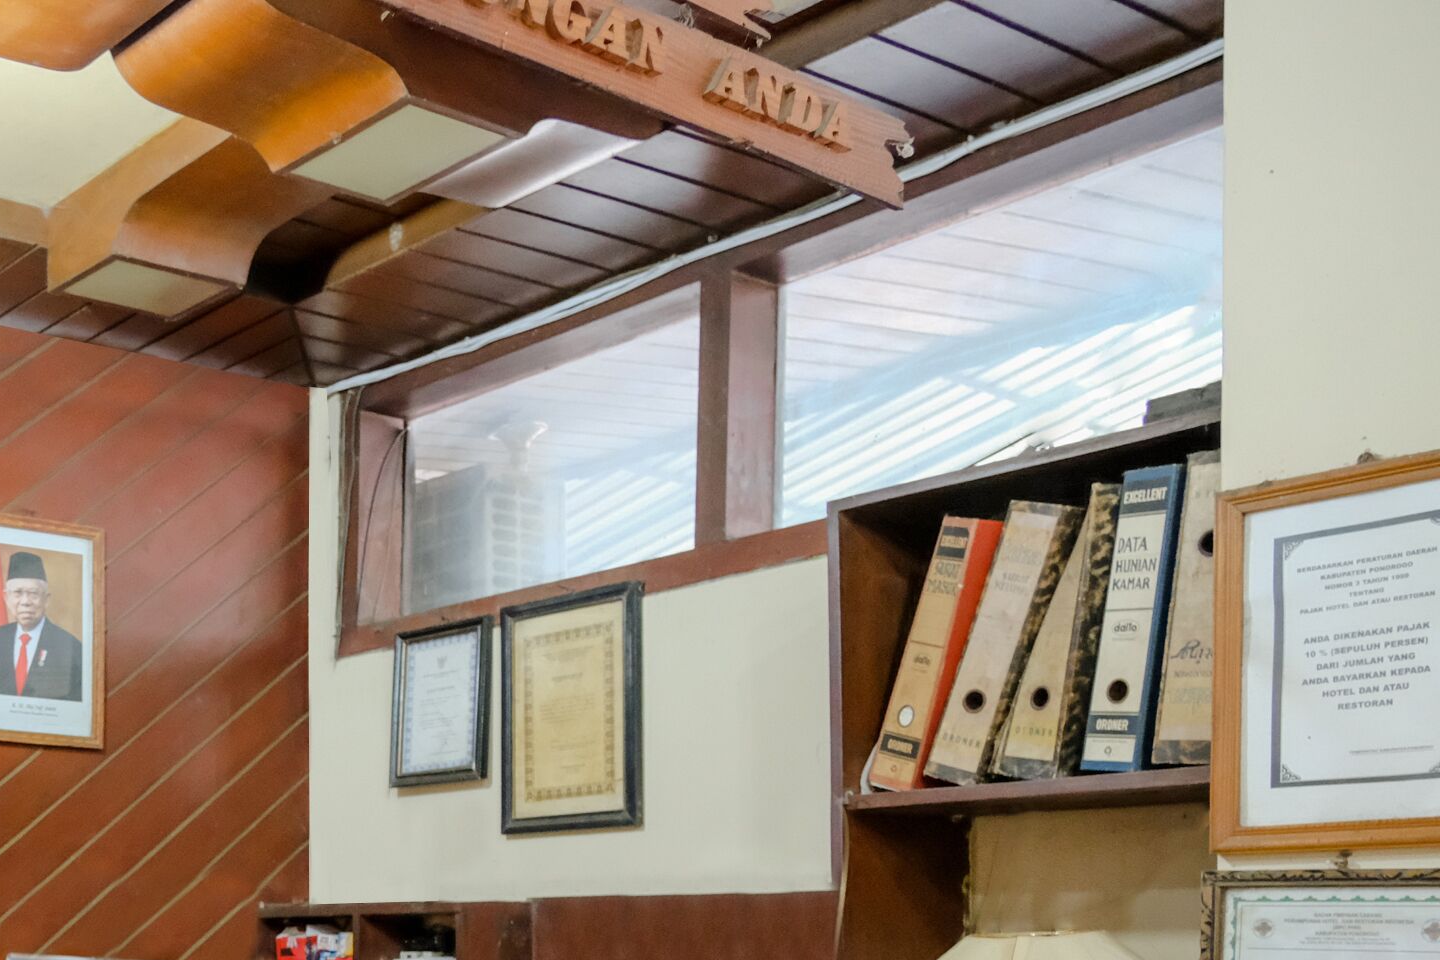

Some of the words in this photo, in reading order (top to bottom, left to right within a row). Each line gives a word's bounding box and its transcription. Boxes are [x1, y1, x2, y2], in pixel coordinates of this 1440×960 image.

[704, 56, 852, 153] ANDA
[1123, 486, 1168, 504] EXCELLENT
[1118, 536, 1148, 554] DATA
[1356, 553, 1403, 565] PERATURAN
[1405, 546, 1438, 557] DAERAH
[1115, 558, 1157, 573] HUNIAN
[1112, 577, 1150, 591] KAMAR
[1320, 569, 1367, 581] KABUPATEN
[1324, 581, 1353, 591] NOMOR
[1362, 576, 1389, 585] TAHUN
[1299, 607, 1324, 615] PAJAK
[1326, 603, 1350, 612] HOTEL
[1353, 600, 1369, 608] DAN
[1371, 597, 1391, 605] ATAU
[1303, 635, 1330, 645] ANDA
[1333, 626, 1393, 641] DIKENAKAN
[1397, 621, 1430, 633] PAJAK
[1305, 650, 1316, 658] 10
[1331, 643, 1381, 657] (SEPULUH
[1384, 636, 1429, 649] PERSEN)
[1316, 662, 1339, 671] DARI
[1342, 656, 1384, 669] JUMLAH
[1388, 652, 1416, 662] YANG
[1302, 677, 1329, 686] ANDA
[1333, 670, 1387, 683] BAYARKAN
[1390, 665, 1431, 677] KEPADA
[1322, 689, 1355, 698] HOTEL
[1358, 686, 1380, 695] DAN
[1383, 682, 1410, 692] ATAU
[1337, 698, 1394, 710] RESTORAN
[1096, 718, 1129, 731] ORDNER
